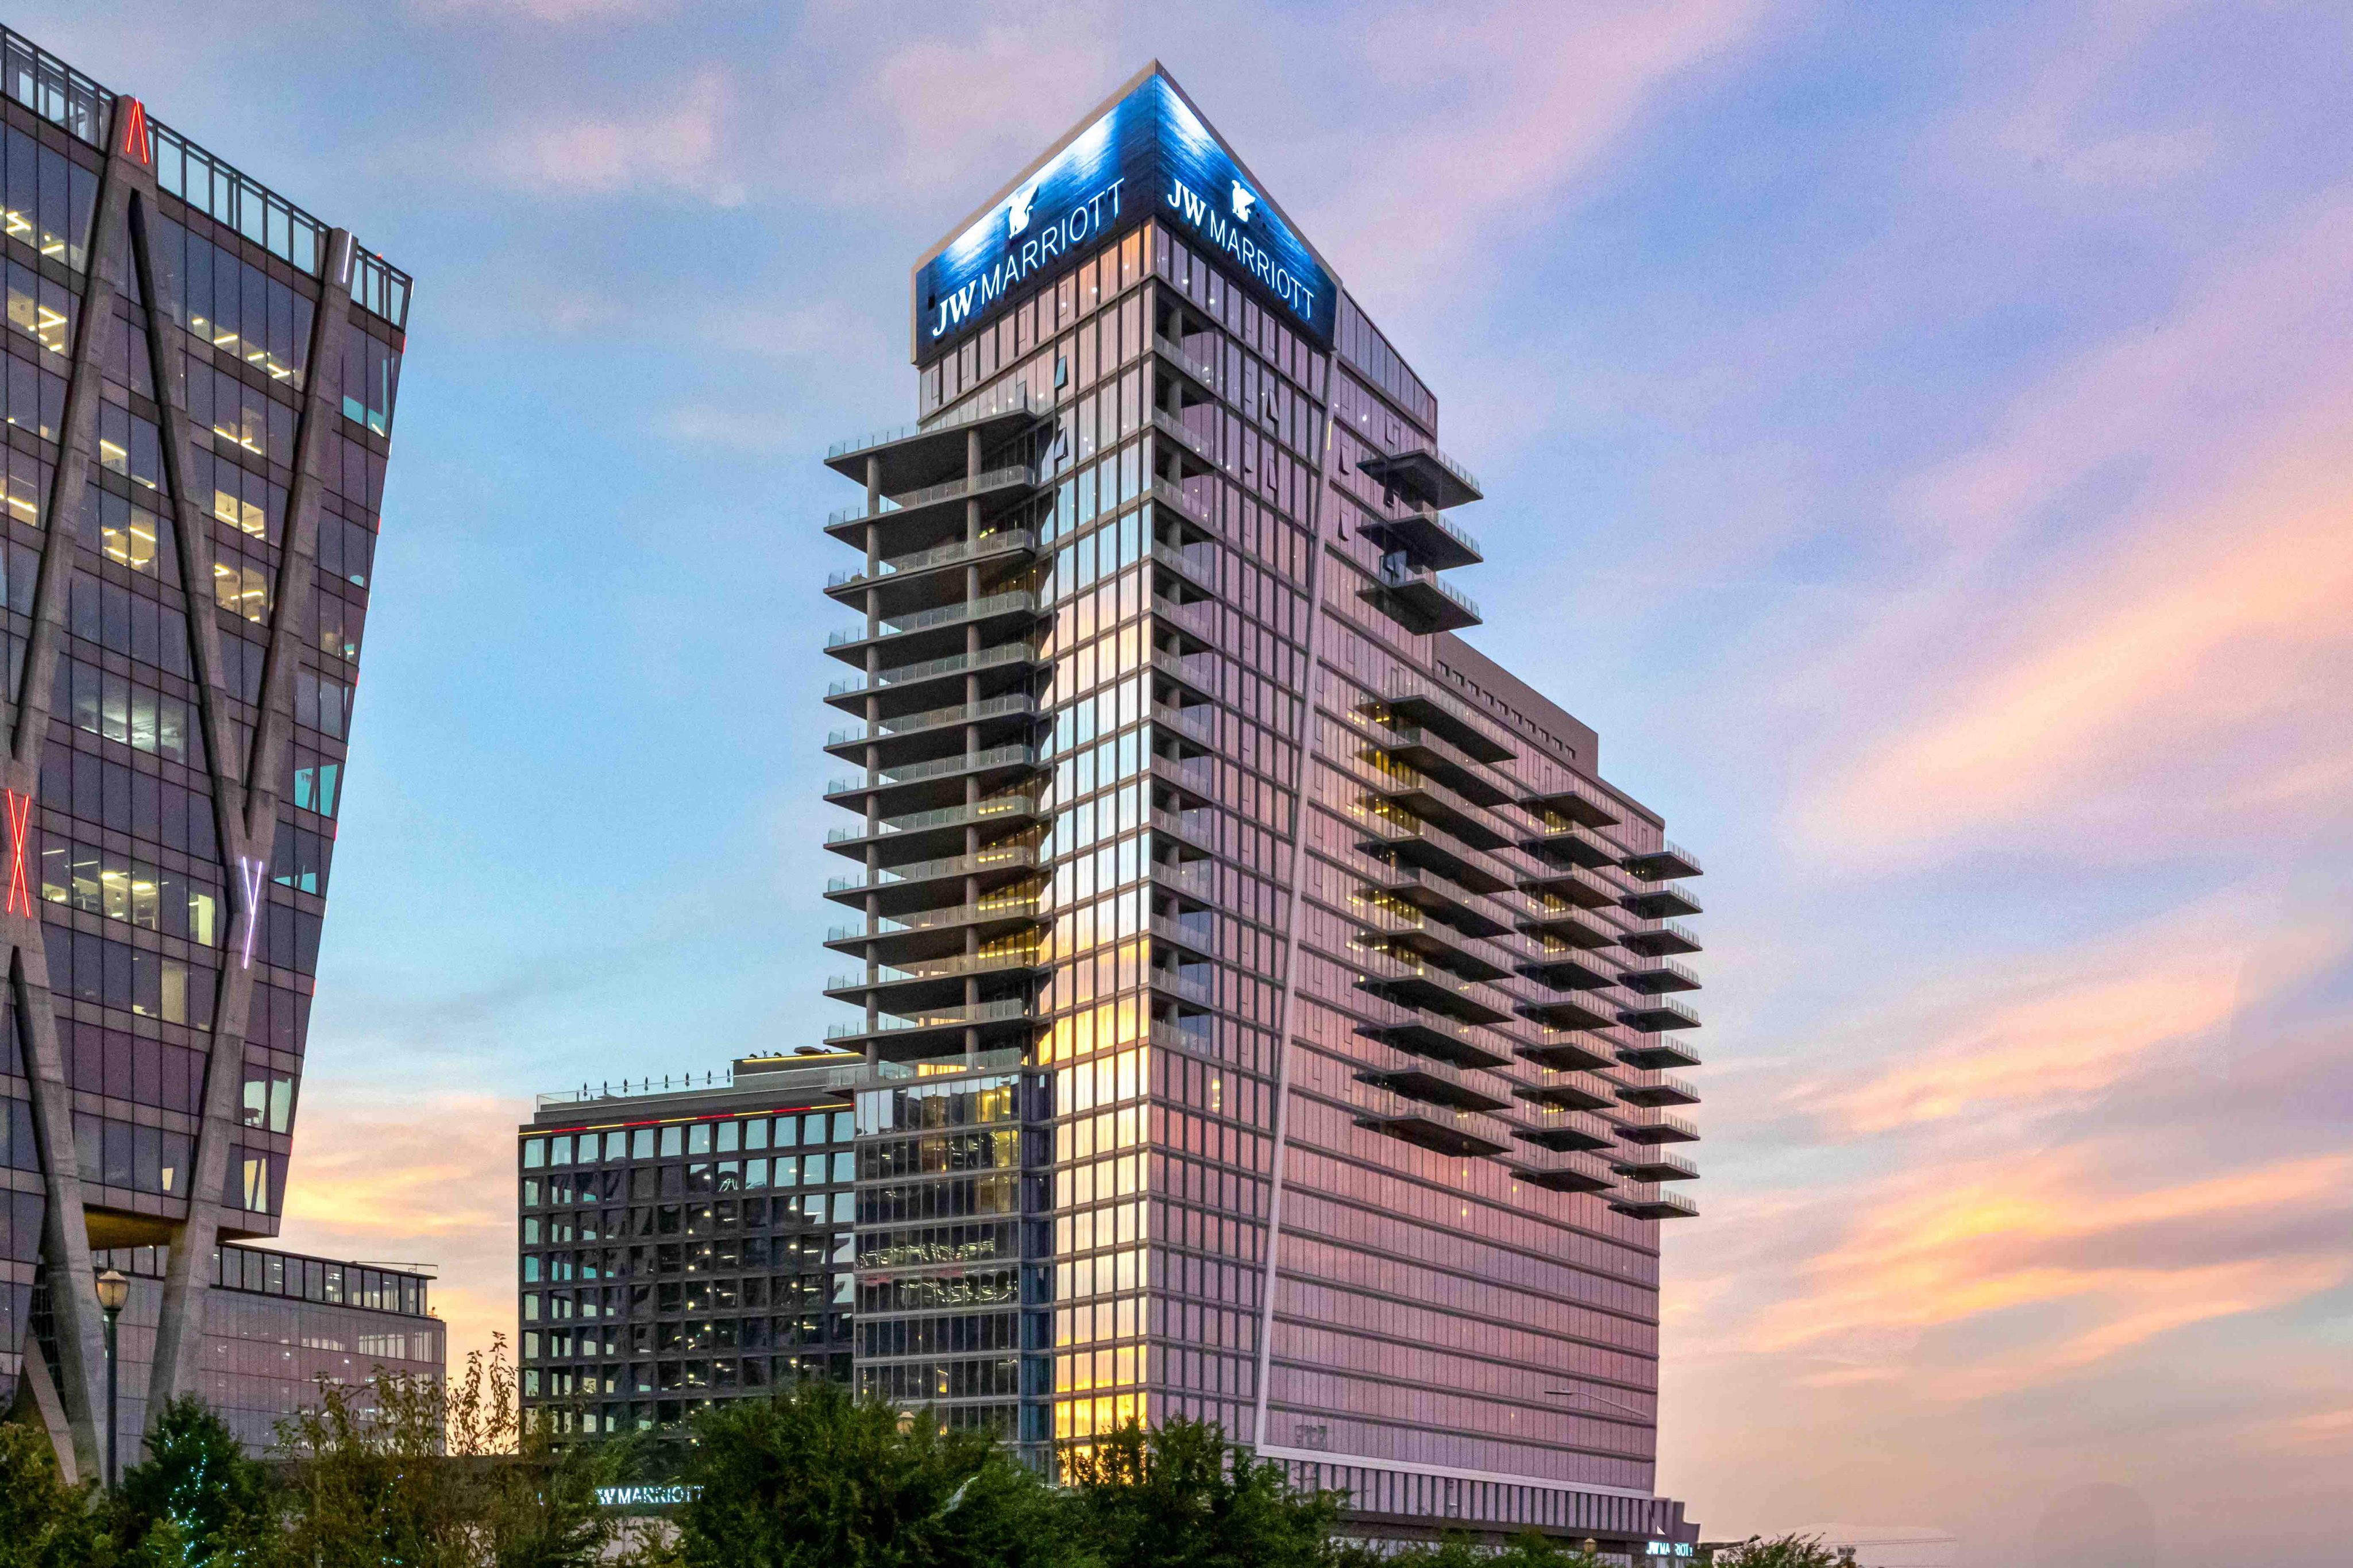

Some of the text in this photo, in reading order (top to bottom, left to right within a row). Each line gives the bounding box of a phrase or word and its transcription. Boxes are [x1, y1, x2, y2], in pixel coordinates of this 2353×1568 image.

[932, 177, 1125, 337] JW MARRIOTT
[1167, 179, 1315, 320] JW MARRIOTT
[595, 1488, 616, 1504] W
[1660, 1542, 1693, 1557] MARIOT
